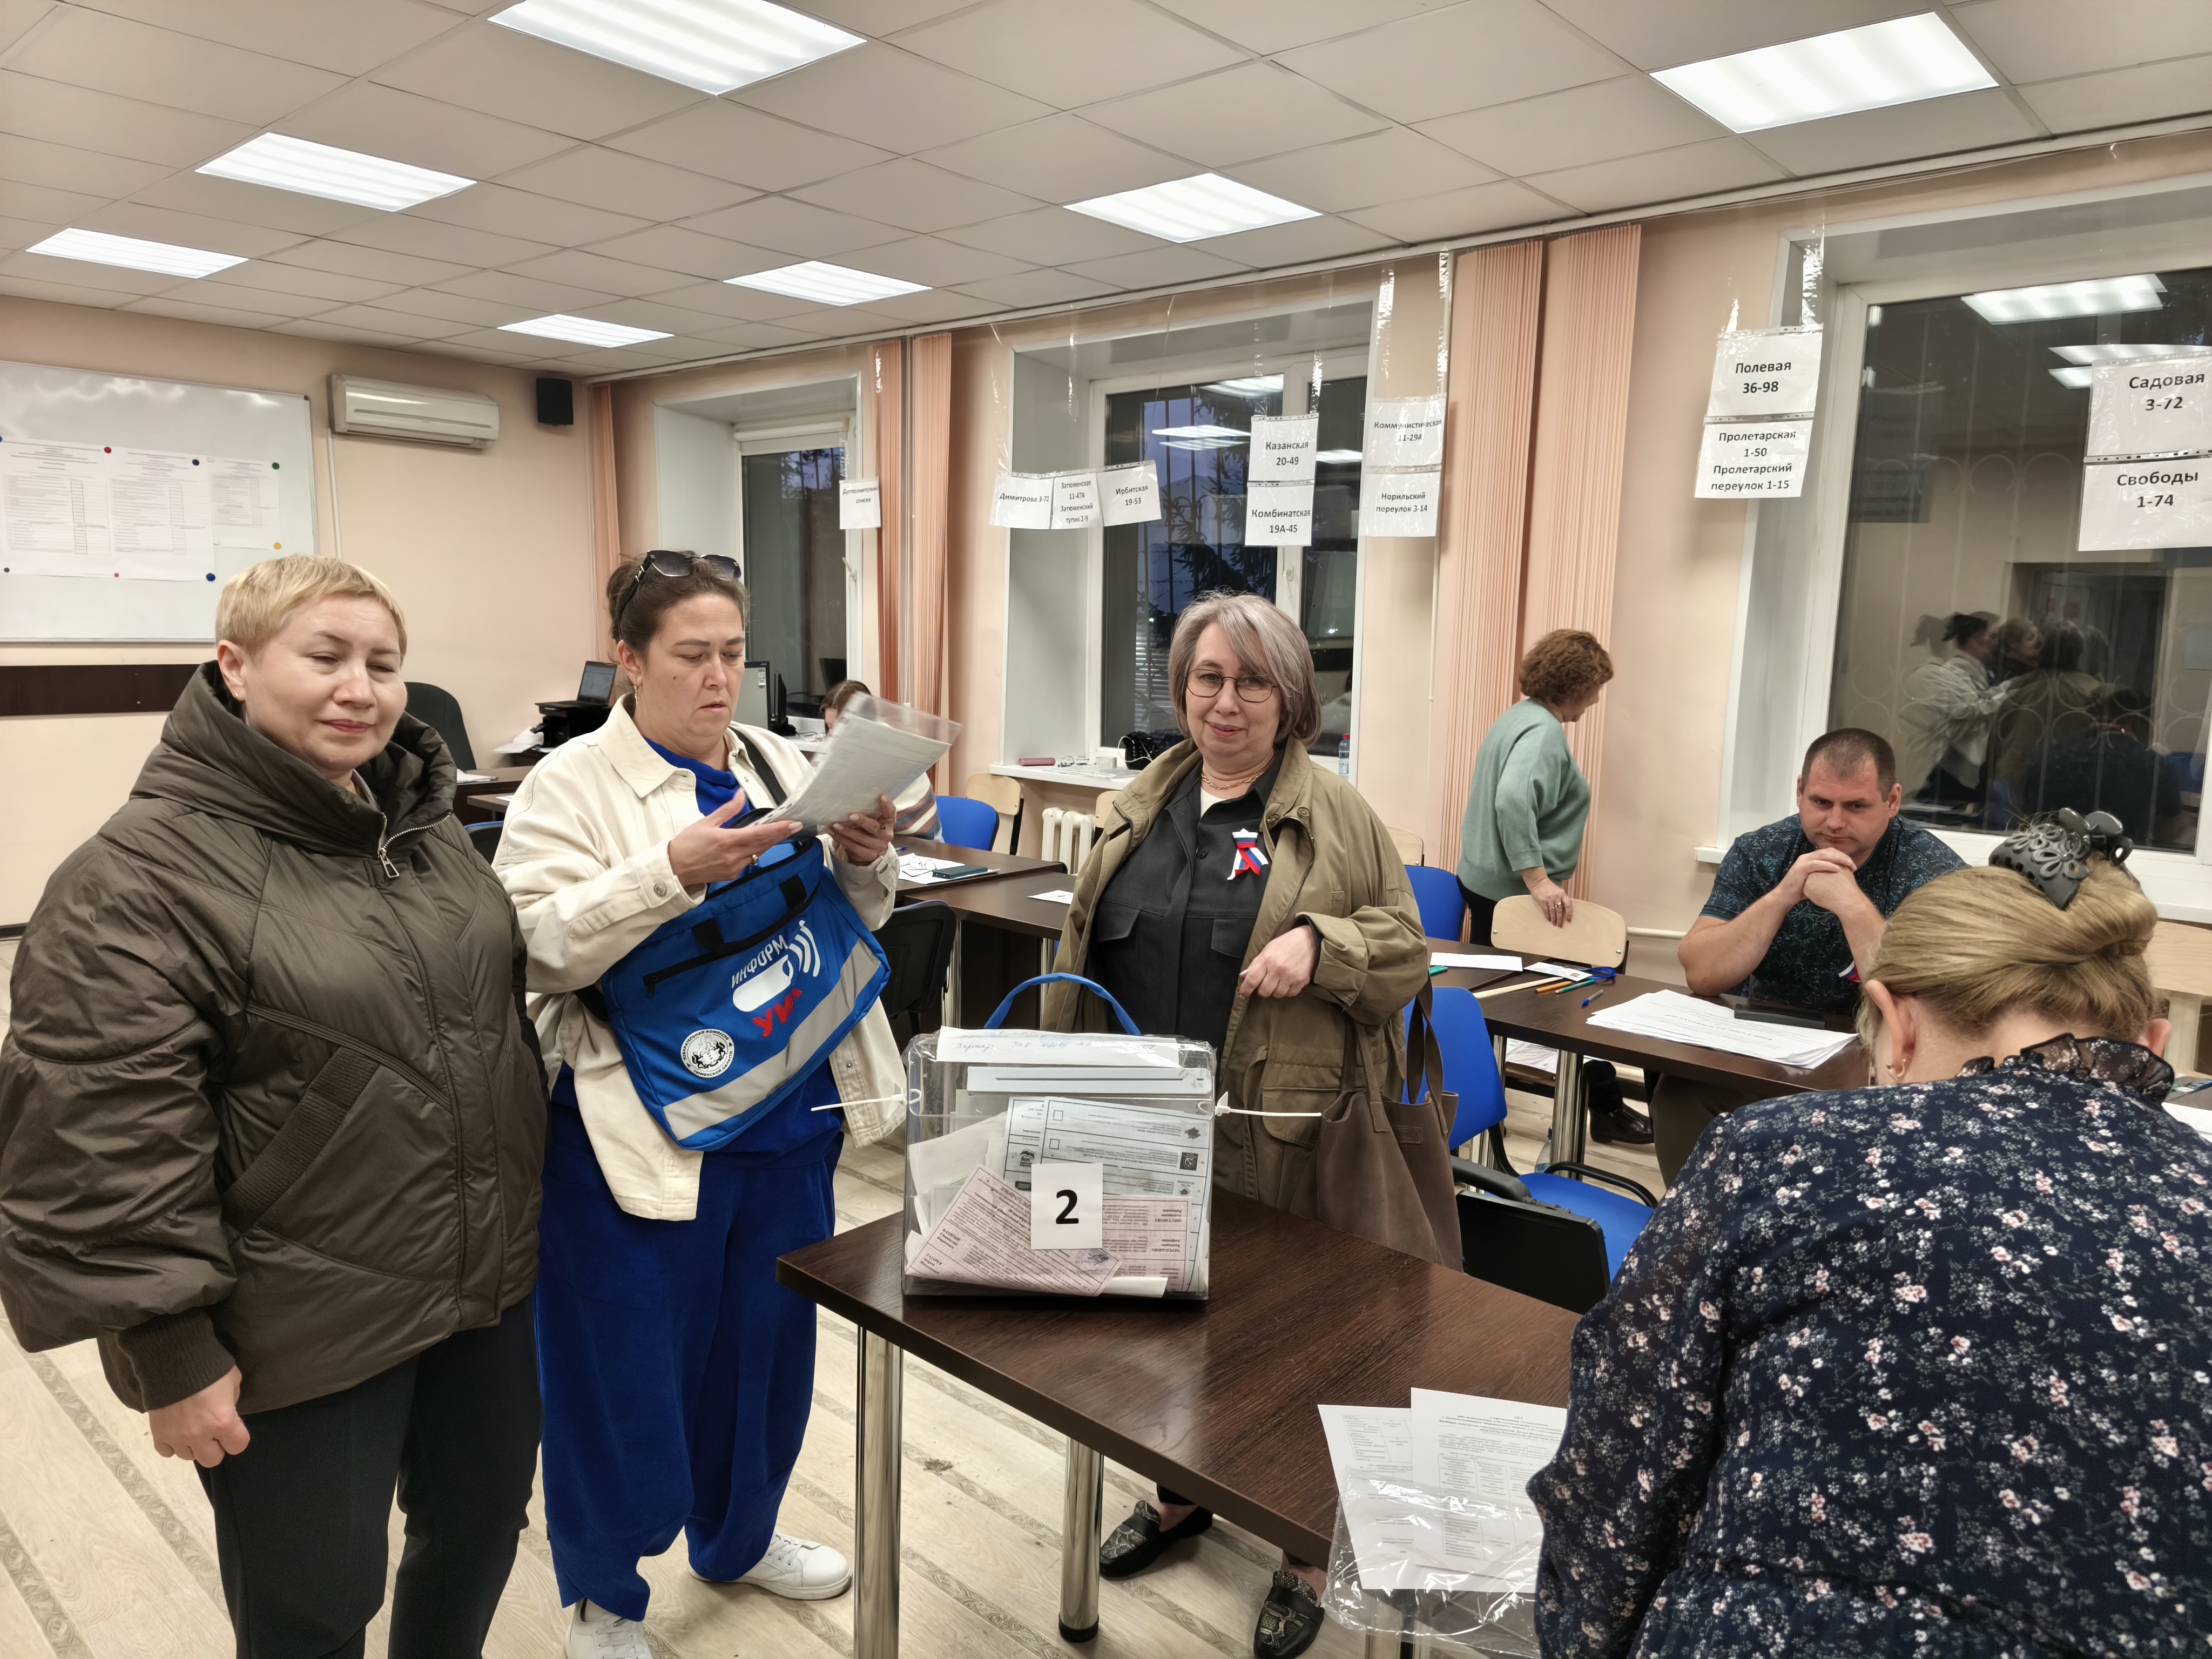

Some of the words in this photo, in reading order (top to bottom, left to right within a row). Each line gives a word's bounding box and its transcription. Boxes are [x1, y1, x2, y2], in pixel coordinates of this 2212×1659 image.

[1735, 362, 1792, 374] Полевая
[2129, 373, 2205, 389] Садовая
[1742, 381, 1779, 394] 36-98
[2145, 396, 2183, 411] 3-72
[1719, 431, 1796, 443] Пролетарская
[1265, 441, 1309, 450] Казанская
[1743, 447, 1768, 457] 1-50
[1276, 456, 1299, 466] 20-49
[1713, 462, 1792, 476] Пролетарский
[2116, 471, 2198, 486] Свободы
[1061, 480, 1091, 489] Затюменская
[1711, 482, 1764, 492] переулок
[1766, 480, 1790, 490] 1-15
[1115, 485, 1149, 496] Ирбитская
[999, 493, 1037, 503] Димитрова
[1069, 492, 1085, 500] 11-47А
[1381, 492, 1426, 502] Норильский
[2136, 494, 2174, 508] 1-74
[1124, 497, 1142, 506] 19-53
[1060, 503, 1094, 512] Затюменский
[1413, 504, 1428, 512] 3-14
[1251, 509, 1311, 518] Комбинатская
[1269, 524, 1298, 533] 19А-45
[731, 935, 788, 989] ИНФОРМ
[1056, 1189, 1079, 1224] 2
